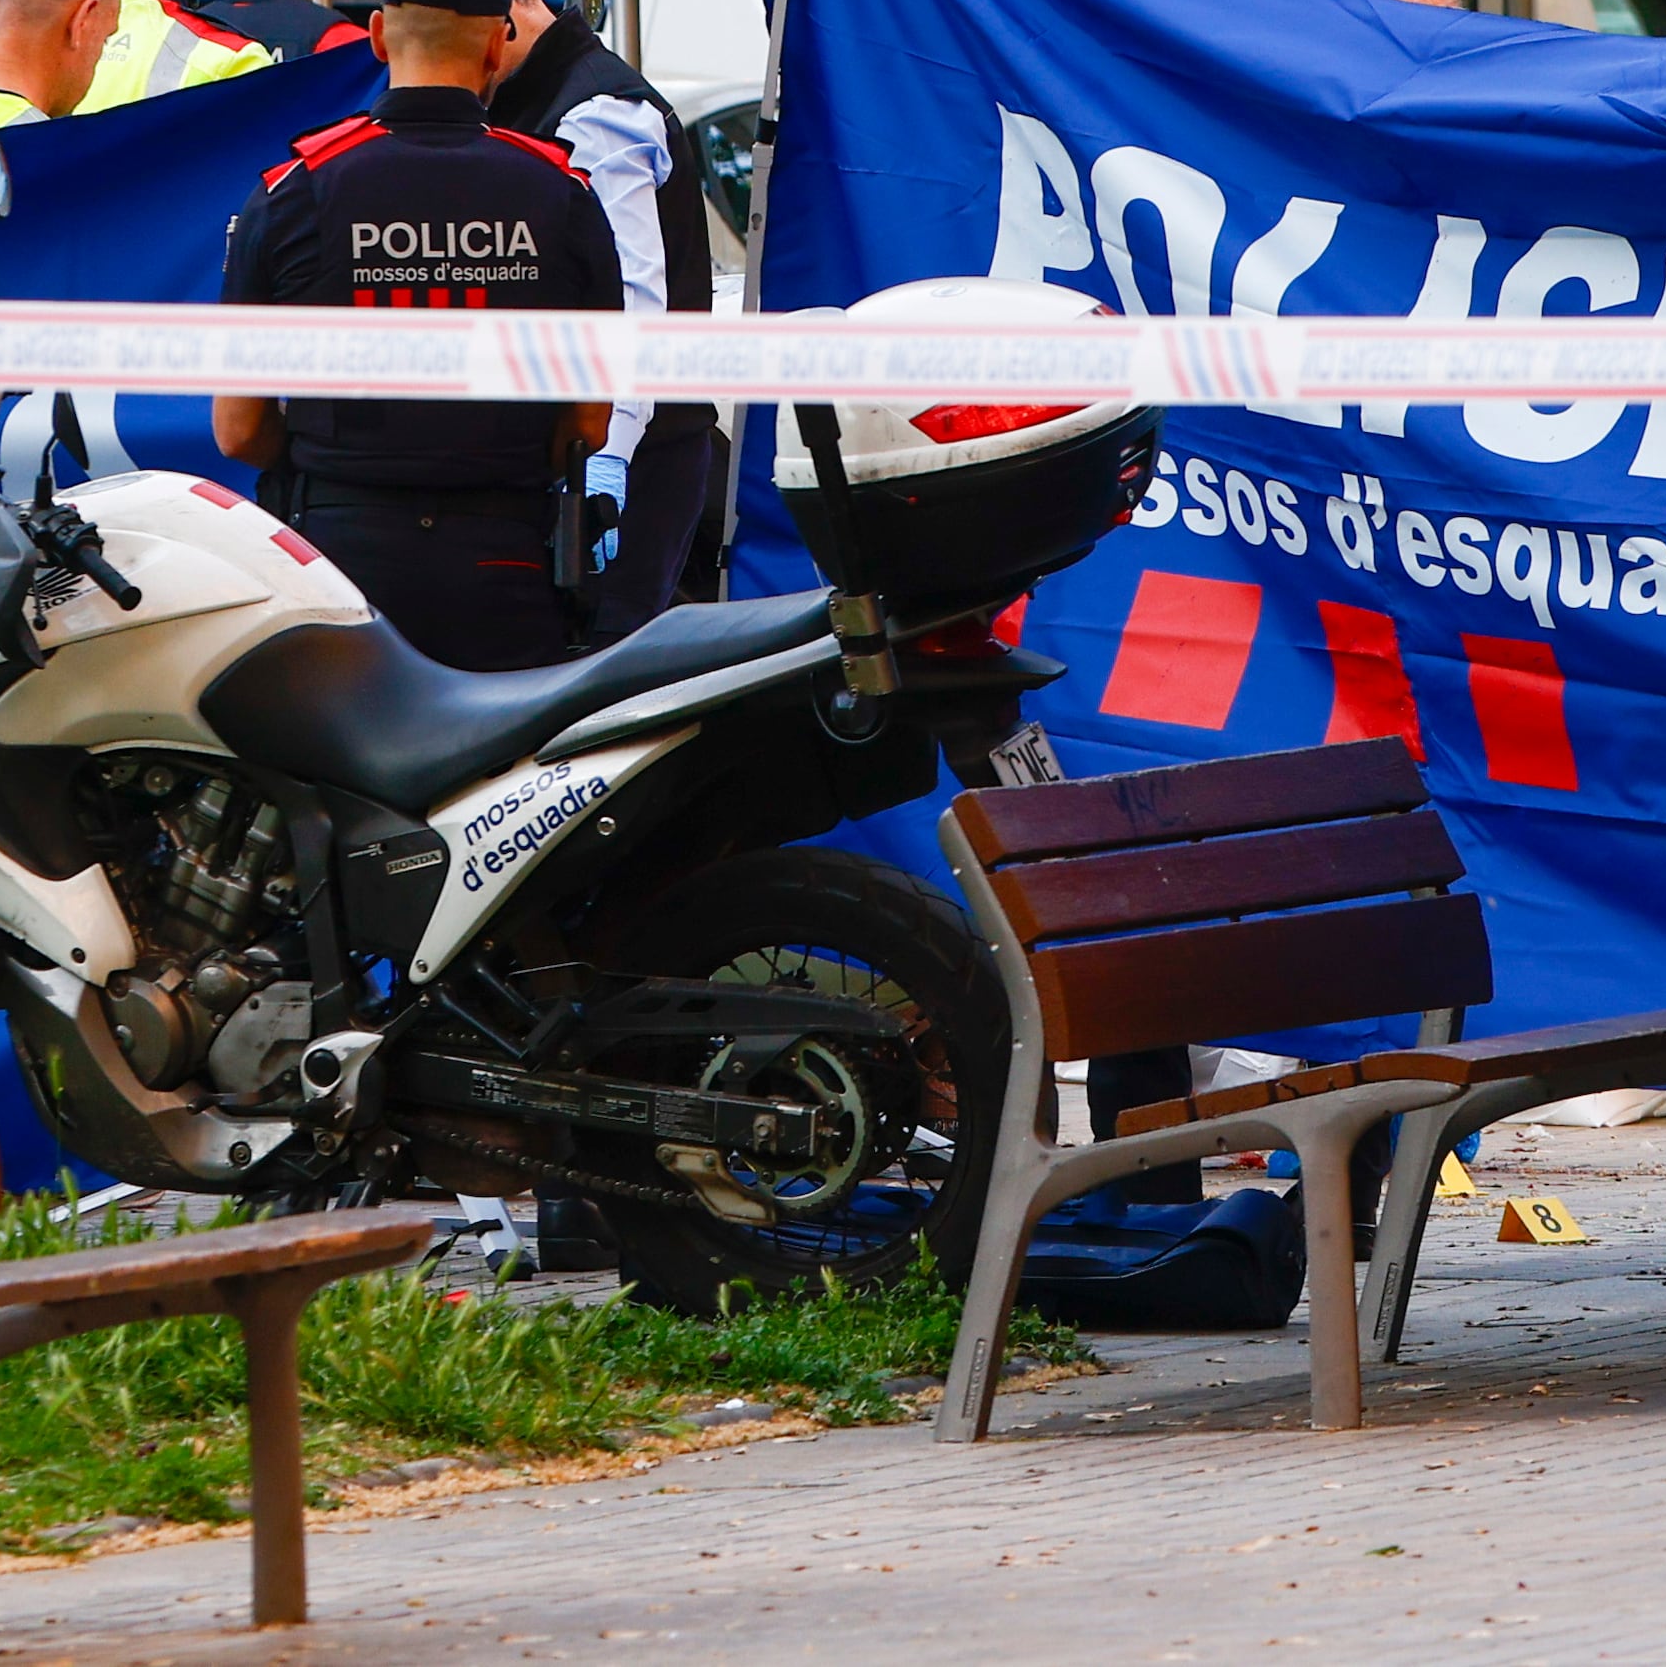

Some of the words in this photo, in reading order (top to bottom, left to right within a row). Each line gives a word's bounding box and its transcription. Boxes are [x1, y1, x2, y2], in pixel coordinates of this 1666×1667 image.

[351, 221, 538, 260] POLICIA
[353, 266, 429, 284] mossos
[434, 262, 539, 285] d'esquadra
[463, 759, 573, 846] mossos
[462, 775, 611, 892] d'esquadra
[387, 852, 440, 873] HONDA
[1531, 1203, 1563, 1235] 8
